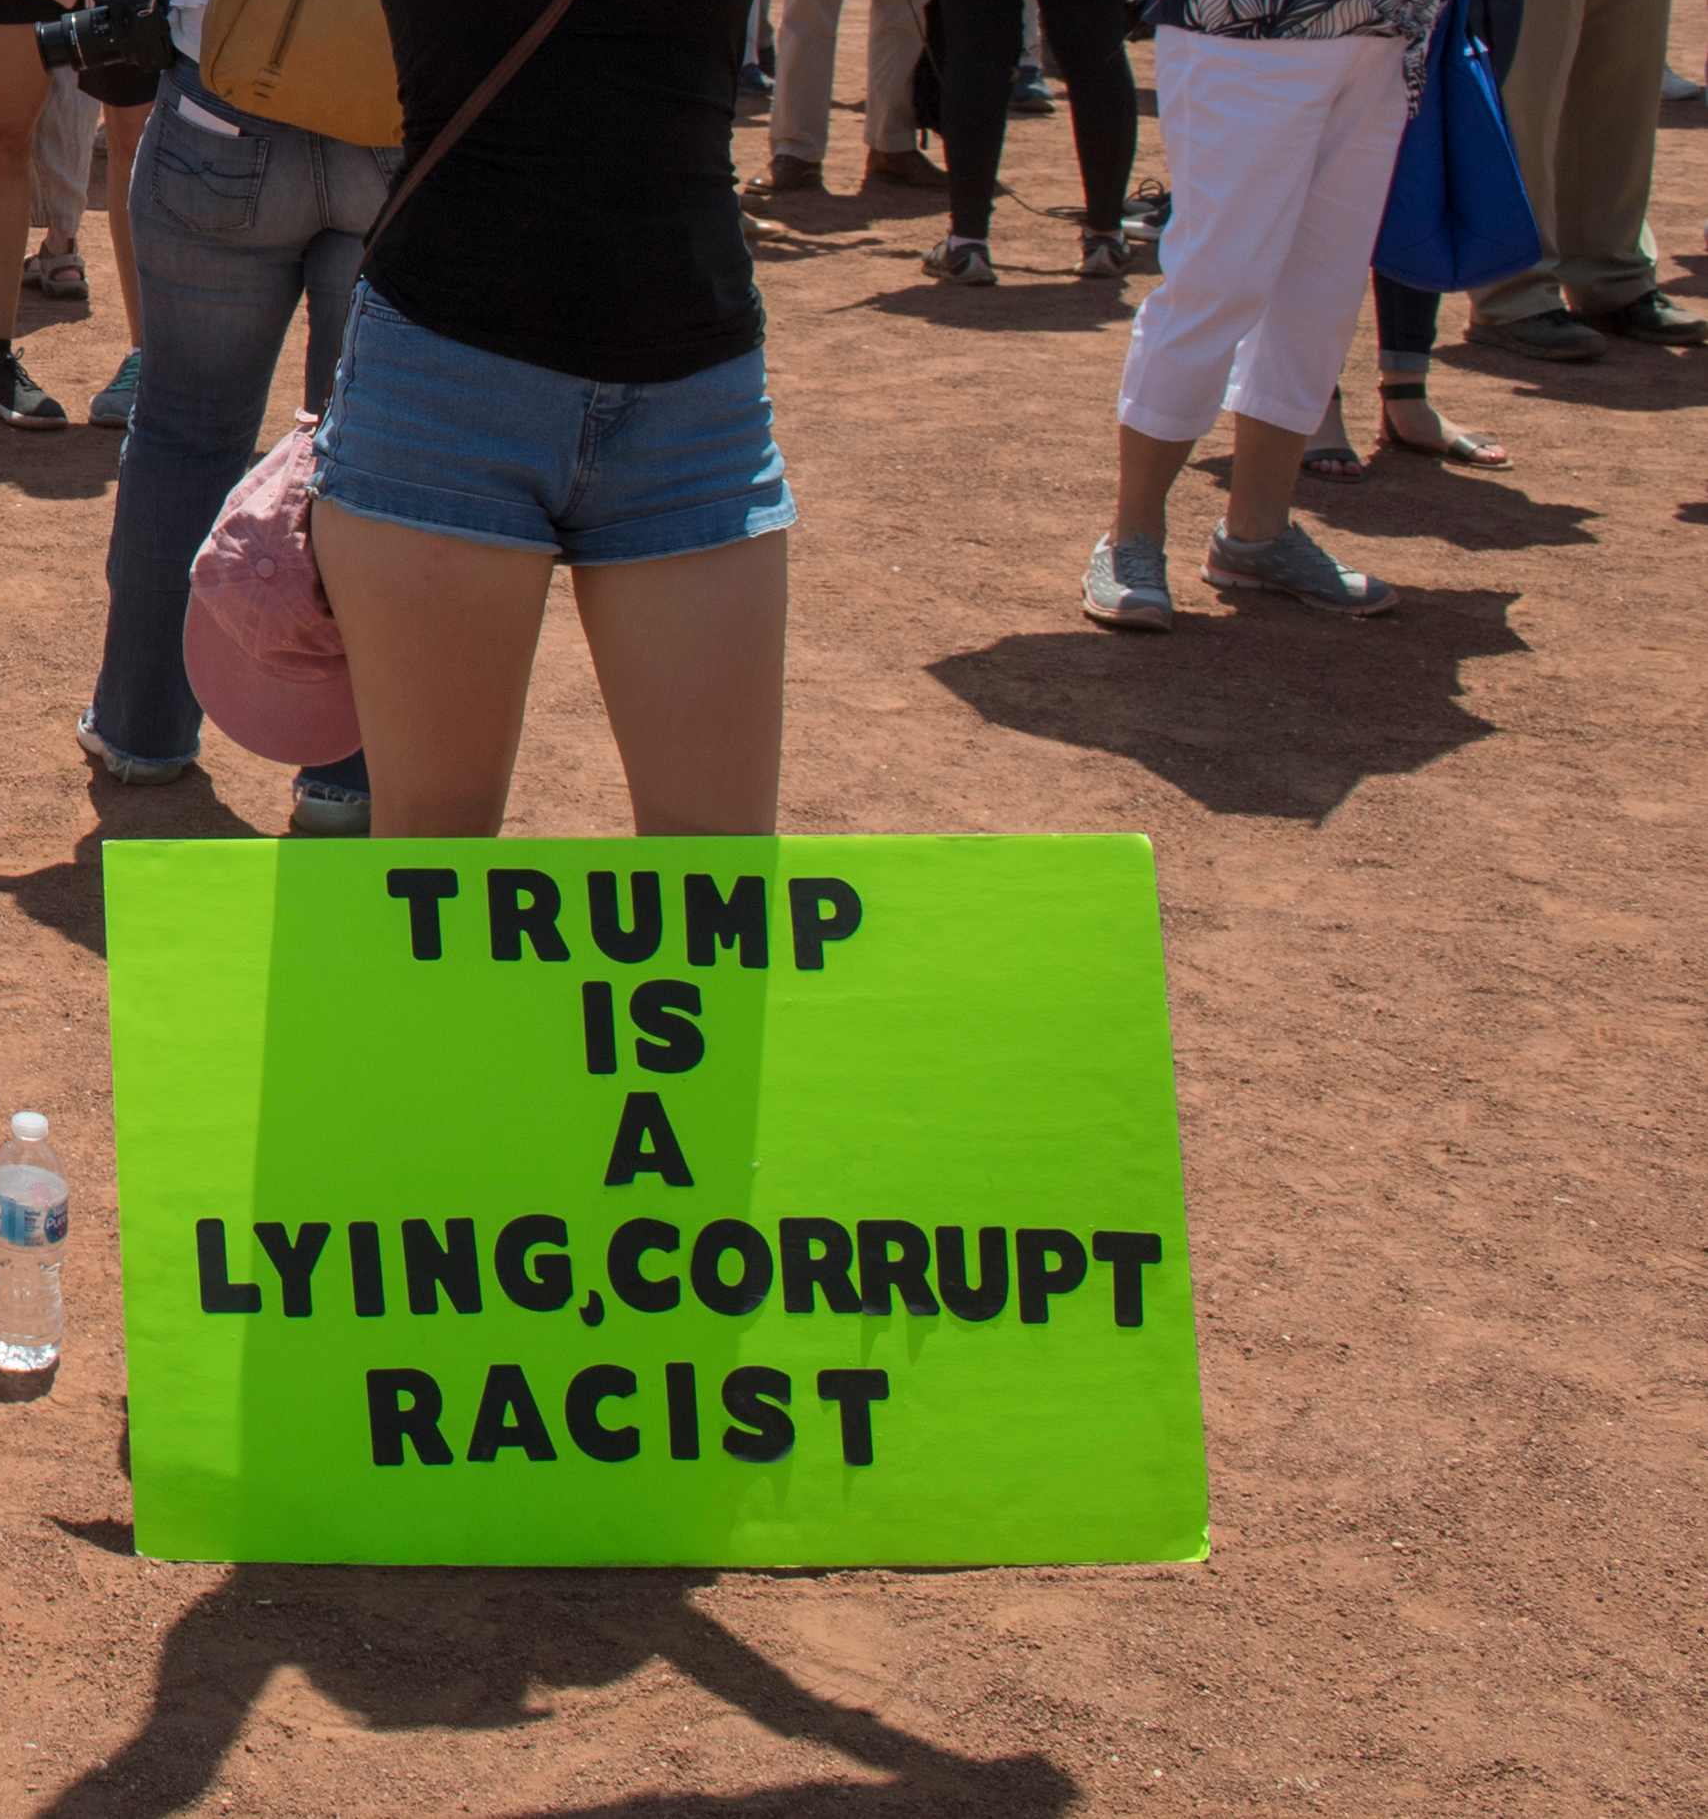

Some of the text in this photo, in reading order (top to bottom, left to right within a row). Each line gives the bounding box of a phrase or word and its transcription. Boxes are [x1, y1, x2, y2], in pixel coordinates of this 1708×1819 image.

[386, 868, 863, 971] TRUMP
[582, 979, 704, 1075] IS
[604, 1091, 693, 1186] A
[365, 1361, 890, 1466] RACIST
